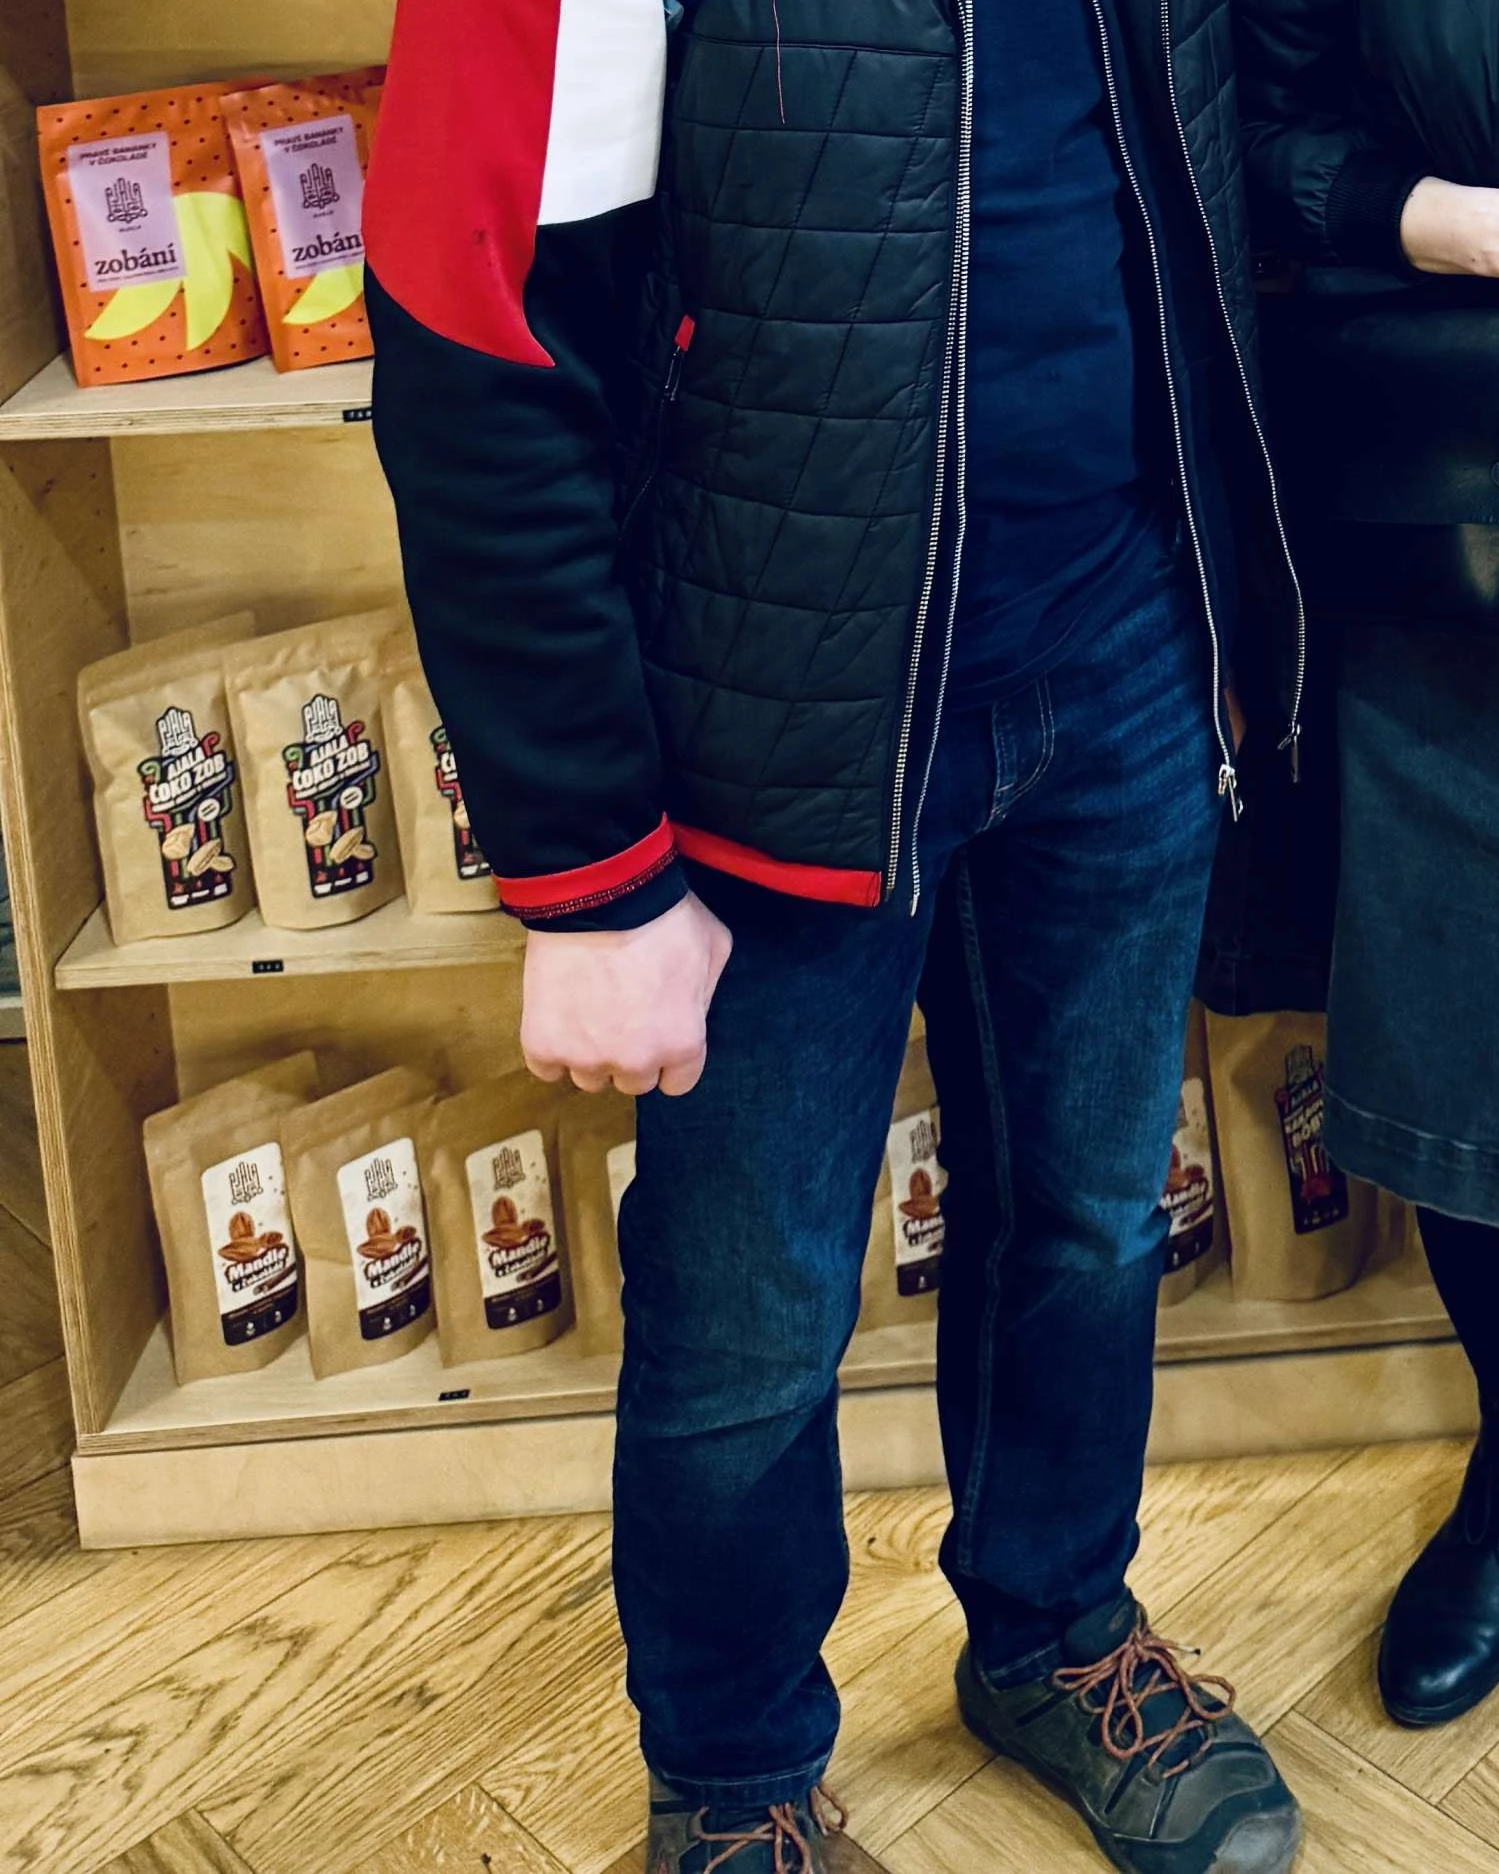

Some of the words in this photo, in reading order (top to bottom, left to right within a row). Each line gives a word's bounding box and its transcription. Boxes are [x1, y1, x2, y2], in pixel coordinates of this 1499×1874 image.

[95, 242, 177, 275] zobání
[292, 230, 362, 264] zobán
[194, 754, 225, 784] ZOB
[336, 742, 370, 774] ZOB
[228, 1247, 287, 1283] Mandle
[368, 1242, 421, 1280] Mandle
[492, 1235, 549, 1268] Mandle
